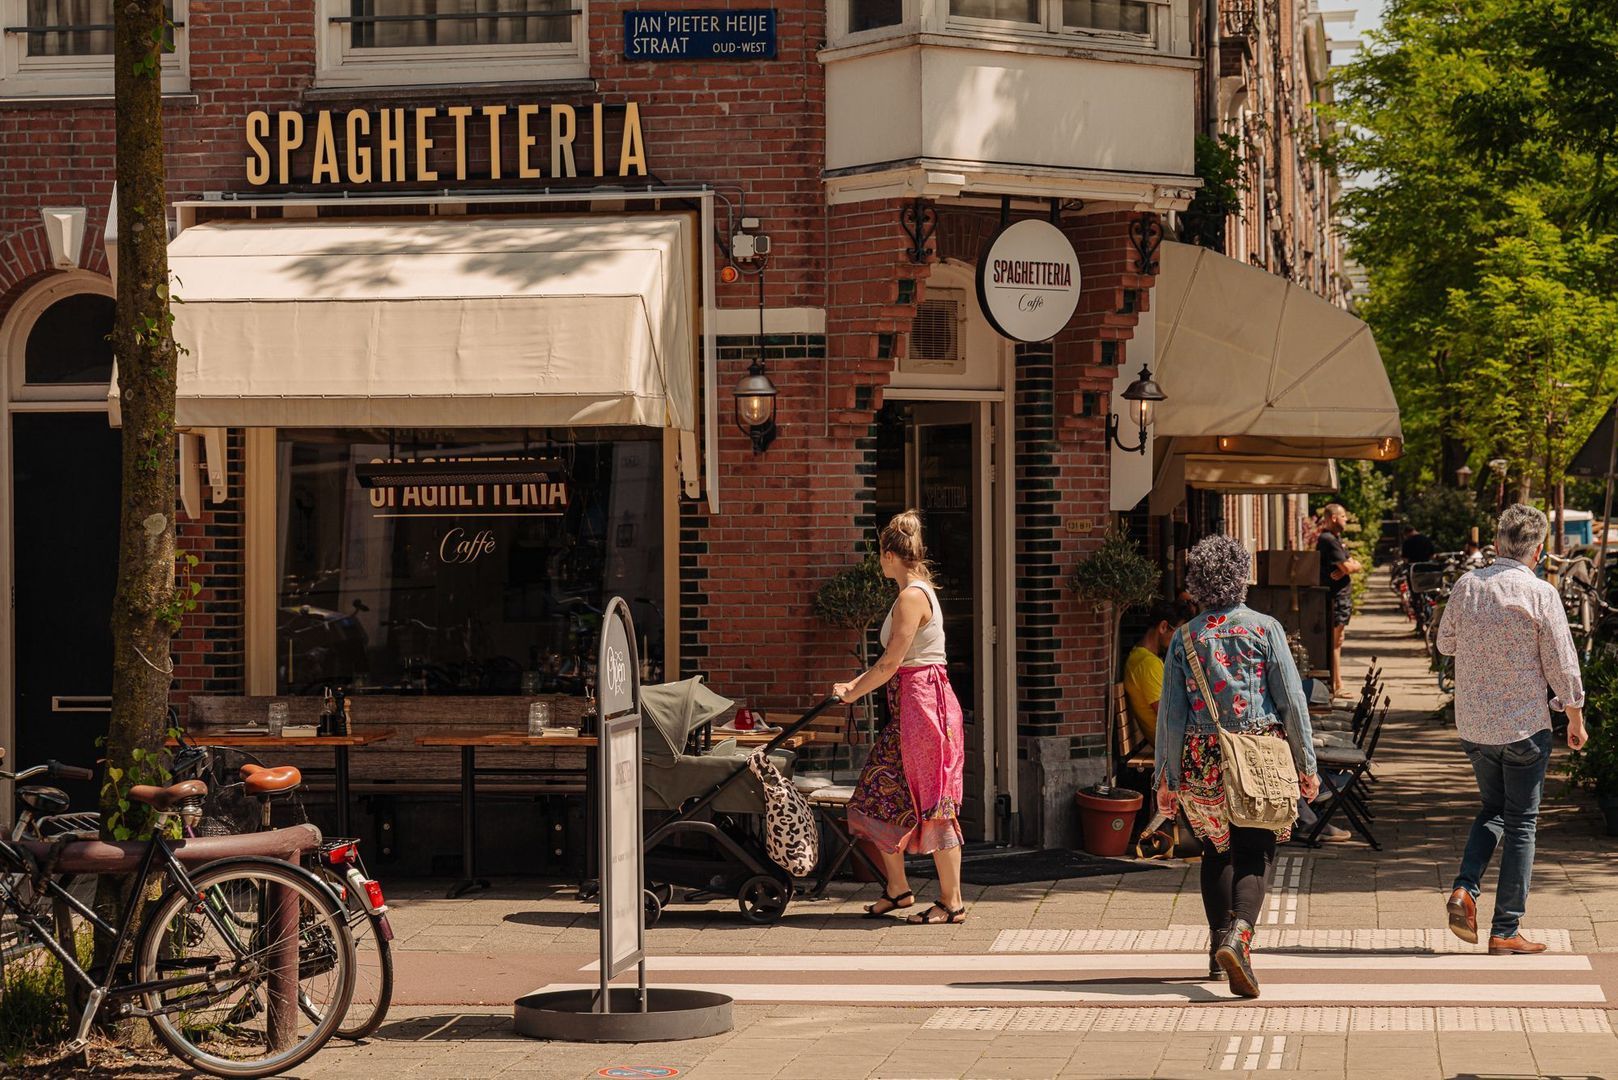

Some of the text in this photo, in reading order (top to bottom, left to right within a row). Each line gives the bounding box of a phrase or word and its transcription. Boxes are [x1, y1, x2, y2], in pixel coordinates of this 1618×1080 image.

[633, 15, 767, 38] JAN PIETER HEIJE
[633, 37, 767, 54] STRAAT OUD-WEST
[245, 102, 649, 186] SPAGHETTERIA
[993, 259, 1072, 287] SPAGHETTERIA
[439, 527, 497, 564] Caffè
